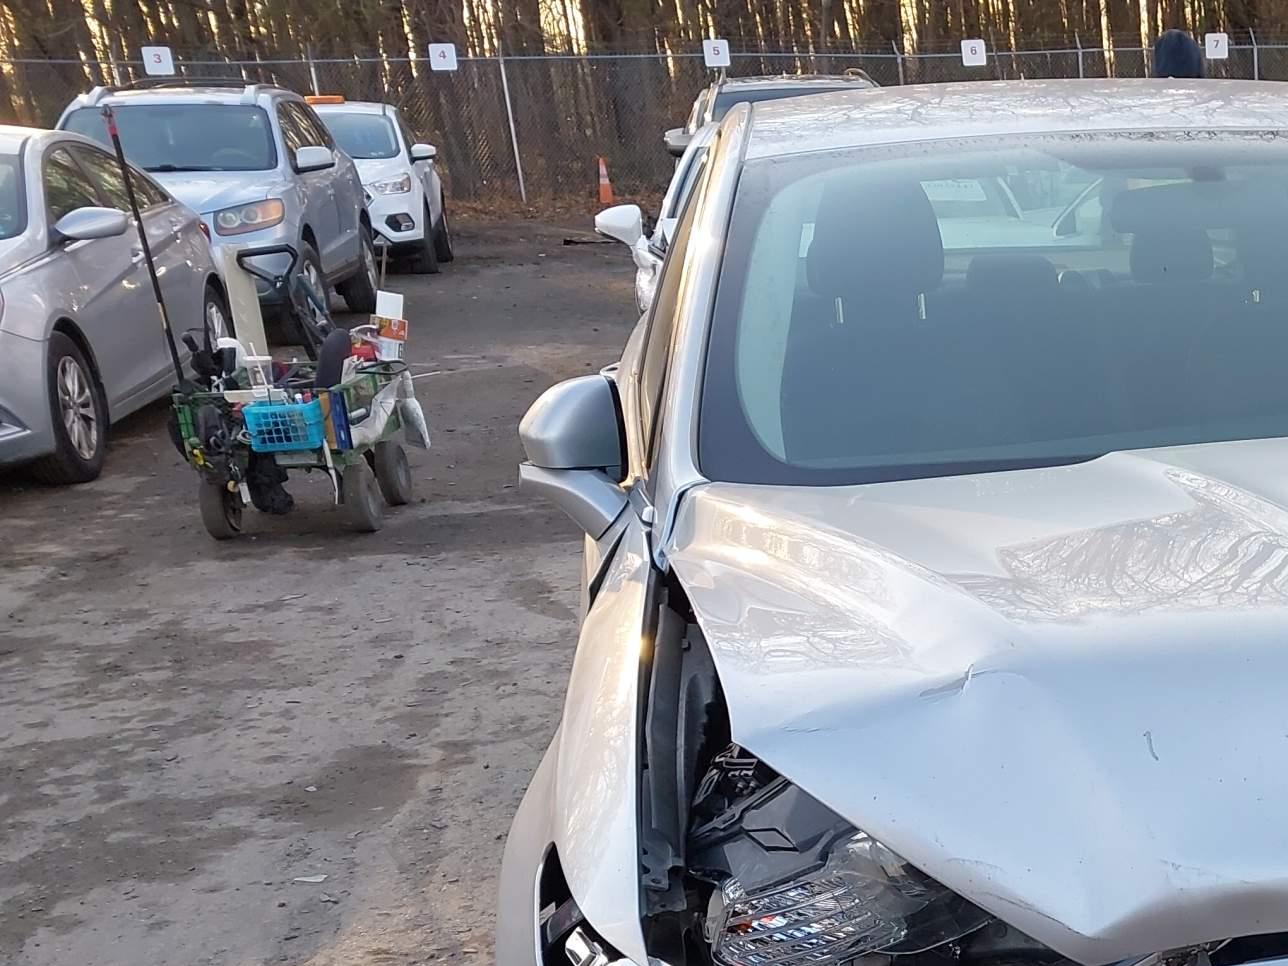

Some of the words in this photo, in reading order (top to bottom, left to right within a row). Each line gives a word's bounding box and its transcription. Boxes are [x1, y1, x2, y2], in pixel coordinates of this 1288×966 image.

[1213, 39, 1220, 49] 7
[438, 50, 447, 60] 4
[712, 46, 720, 56] 5
[970, 47, 977, 56] 6
[153, 53, 162, 64] 3
